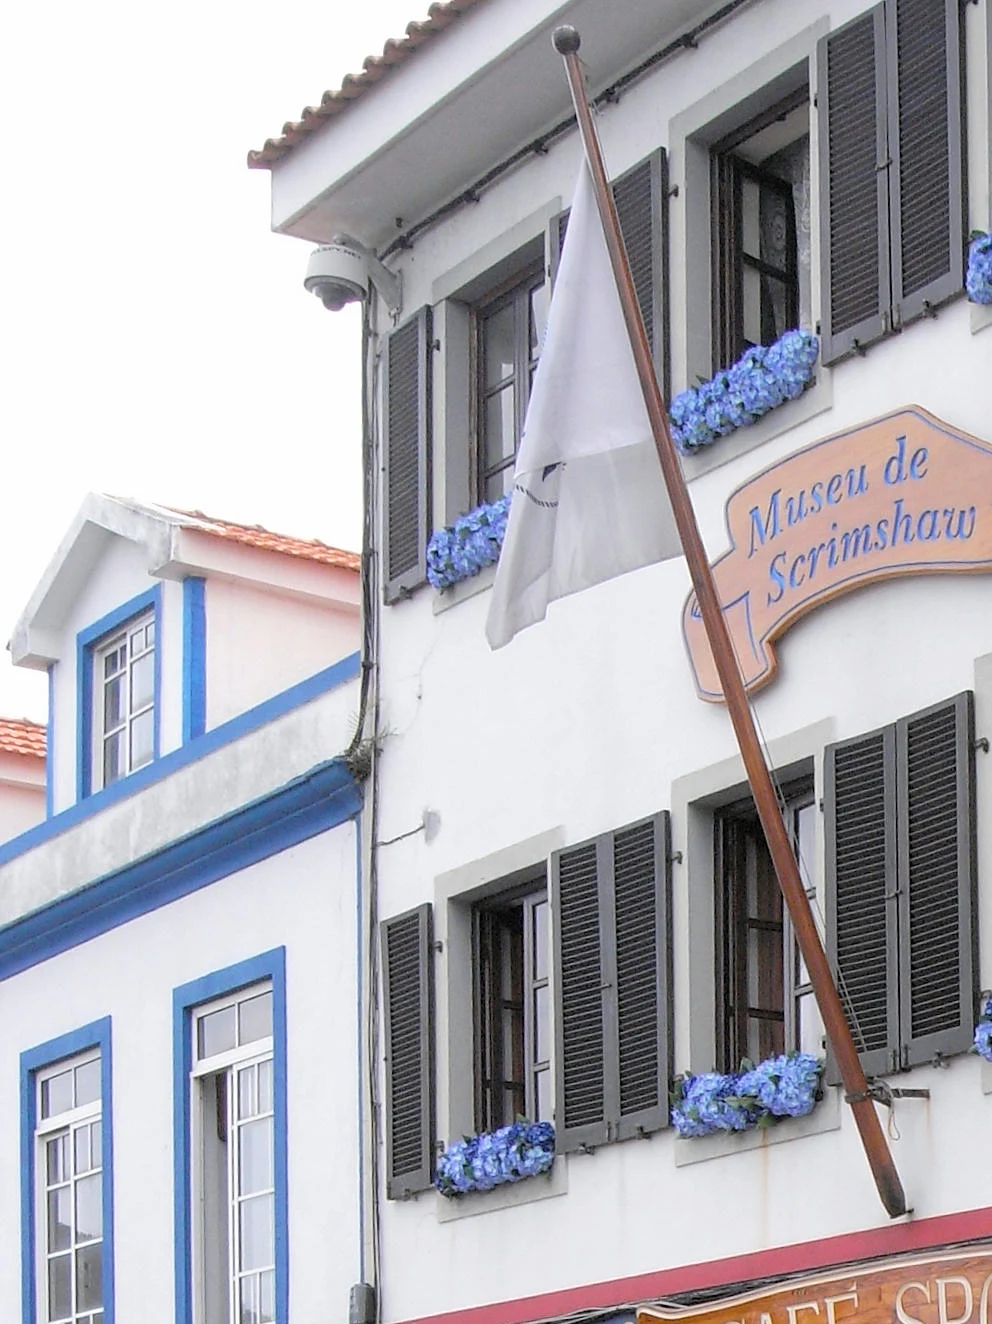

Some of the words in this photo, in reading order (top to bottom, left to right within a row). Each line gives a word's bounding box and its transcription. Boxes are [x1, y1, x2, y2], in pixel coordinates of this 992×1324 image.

[748, 465, 869, 558] Museu
[884, 435, 929, 486] de
[767, 499, 976, 607] Scrimshaw
